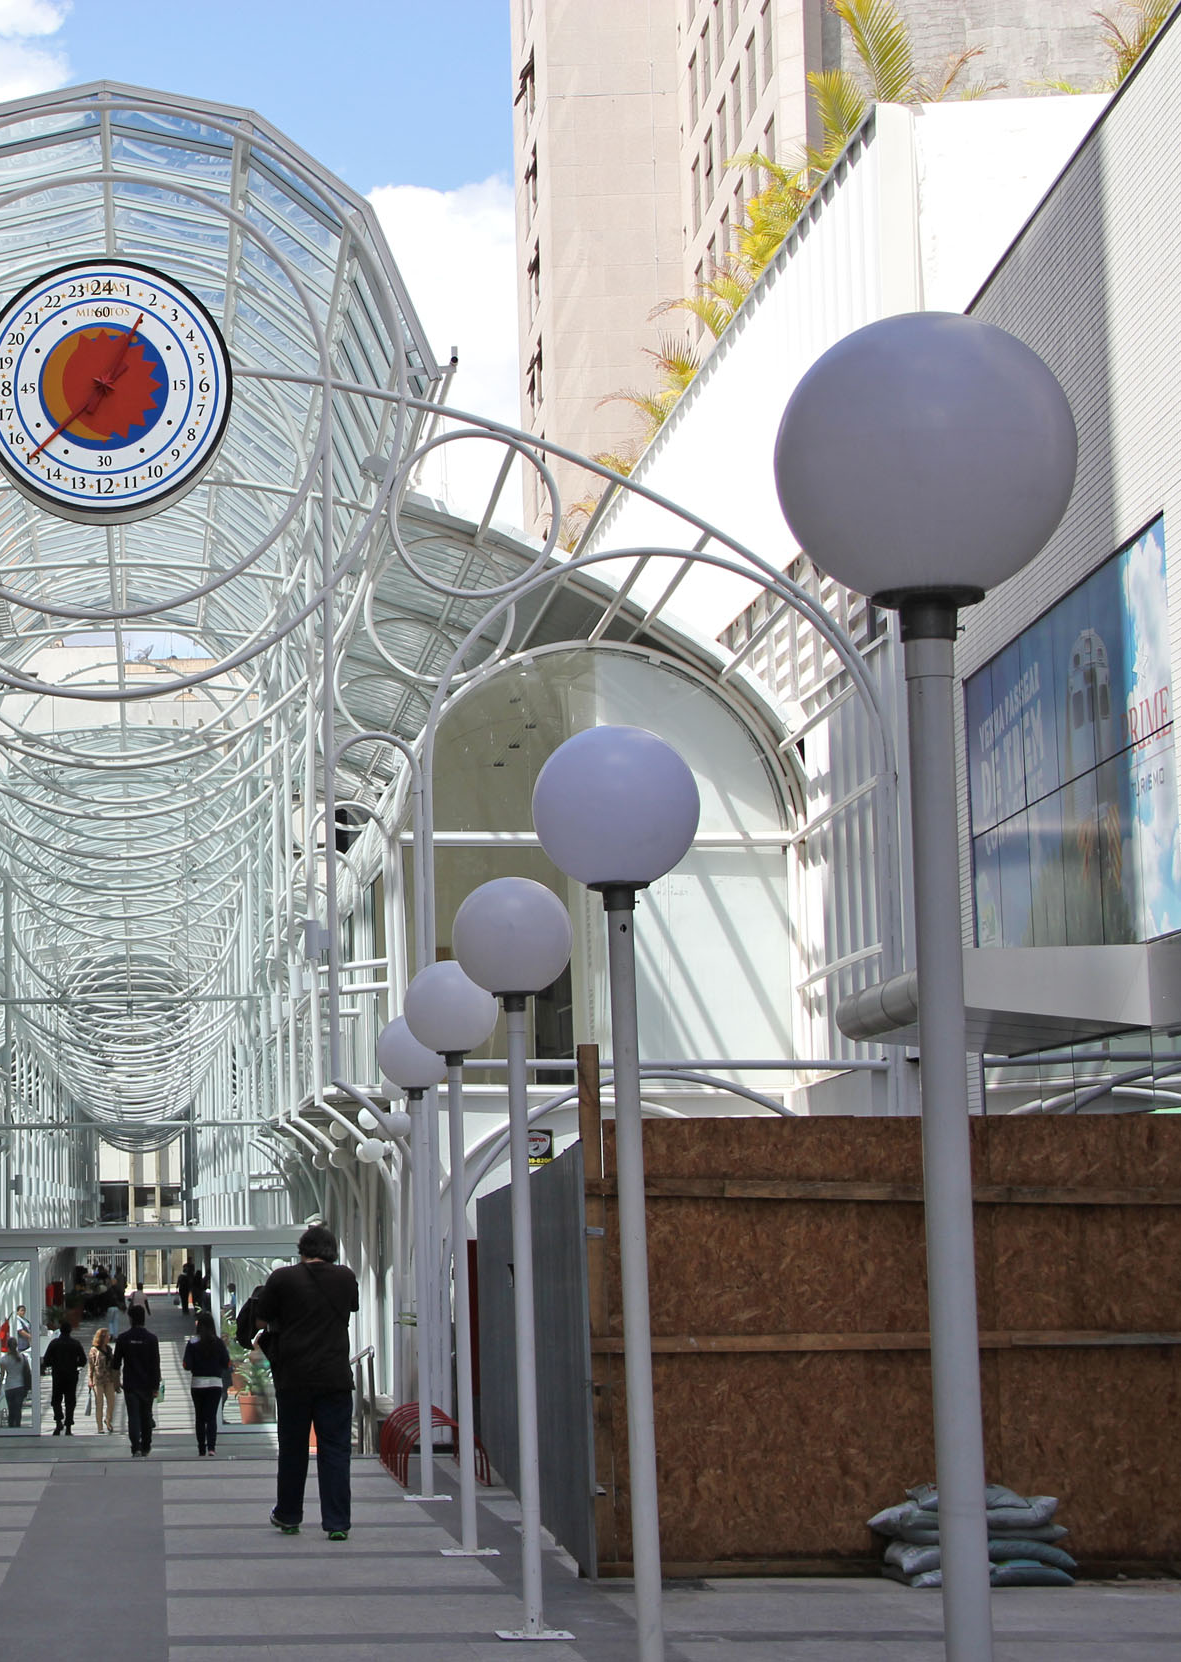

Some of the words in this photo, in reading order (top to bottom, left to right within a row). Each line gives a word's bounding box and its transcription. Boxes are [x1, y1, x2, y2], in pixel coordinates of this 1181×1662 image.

[68, 284, 85, 297] 23
[90, 280, 114, 295] 24
[125, 285, 130, 296] 1
[44, 296, 61, 307] 22
[148, 294, 157, 305] 2
[24, 312, 39, 324] 21
[94, 307, 110, 317] 60
[171, 309, 179, 321] 3
[7, 333, 25, 345] 20
[185, 330, 195, 341] 4
[0, 357, 14, 369] 19
[197, 353, 205, 365] 5
[20, 383, 36, 393] 45
[173, 380, 186, 390] 15
[198, 377, 210, 392] 6
[0, 409, 14, 420] 17
[196, 405, 206, 416] 7
[9, 433, 25, 444] 16
[186, 428, 196, 441] 8
[98, 456, 112, 466] 30
[171, 449, 181, 461] 9
[46, 468, 62, 480] 14
[147, 465, 163, 477] 10
[71, 477, 86, 489] 13
[96, 478, 115, 493] 12
[124, 476, 137, 488] 11
[980, 745, 1002, 817] DE
